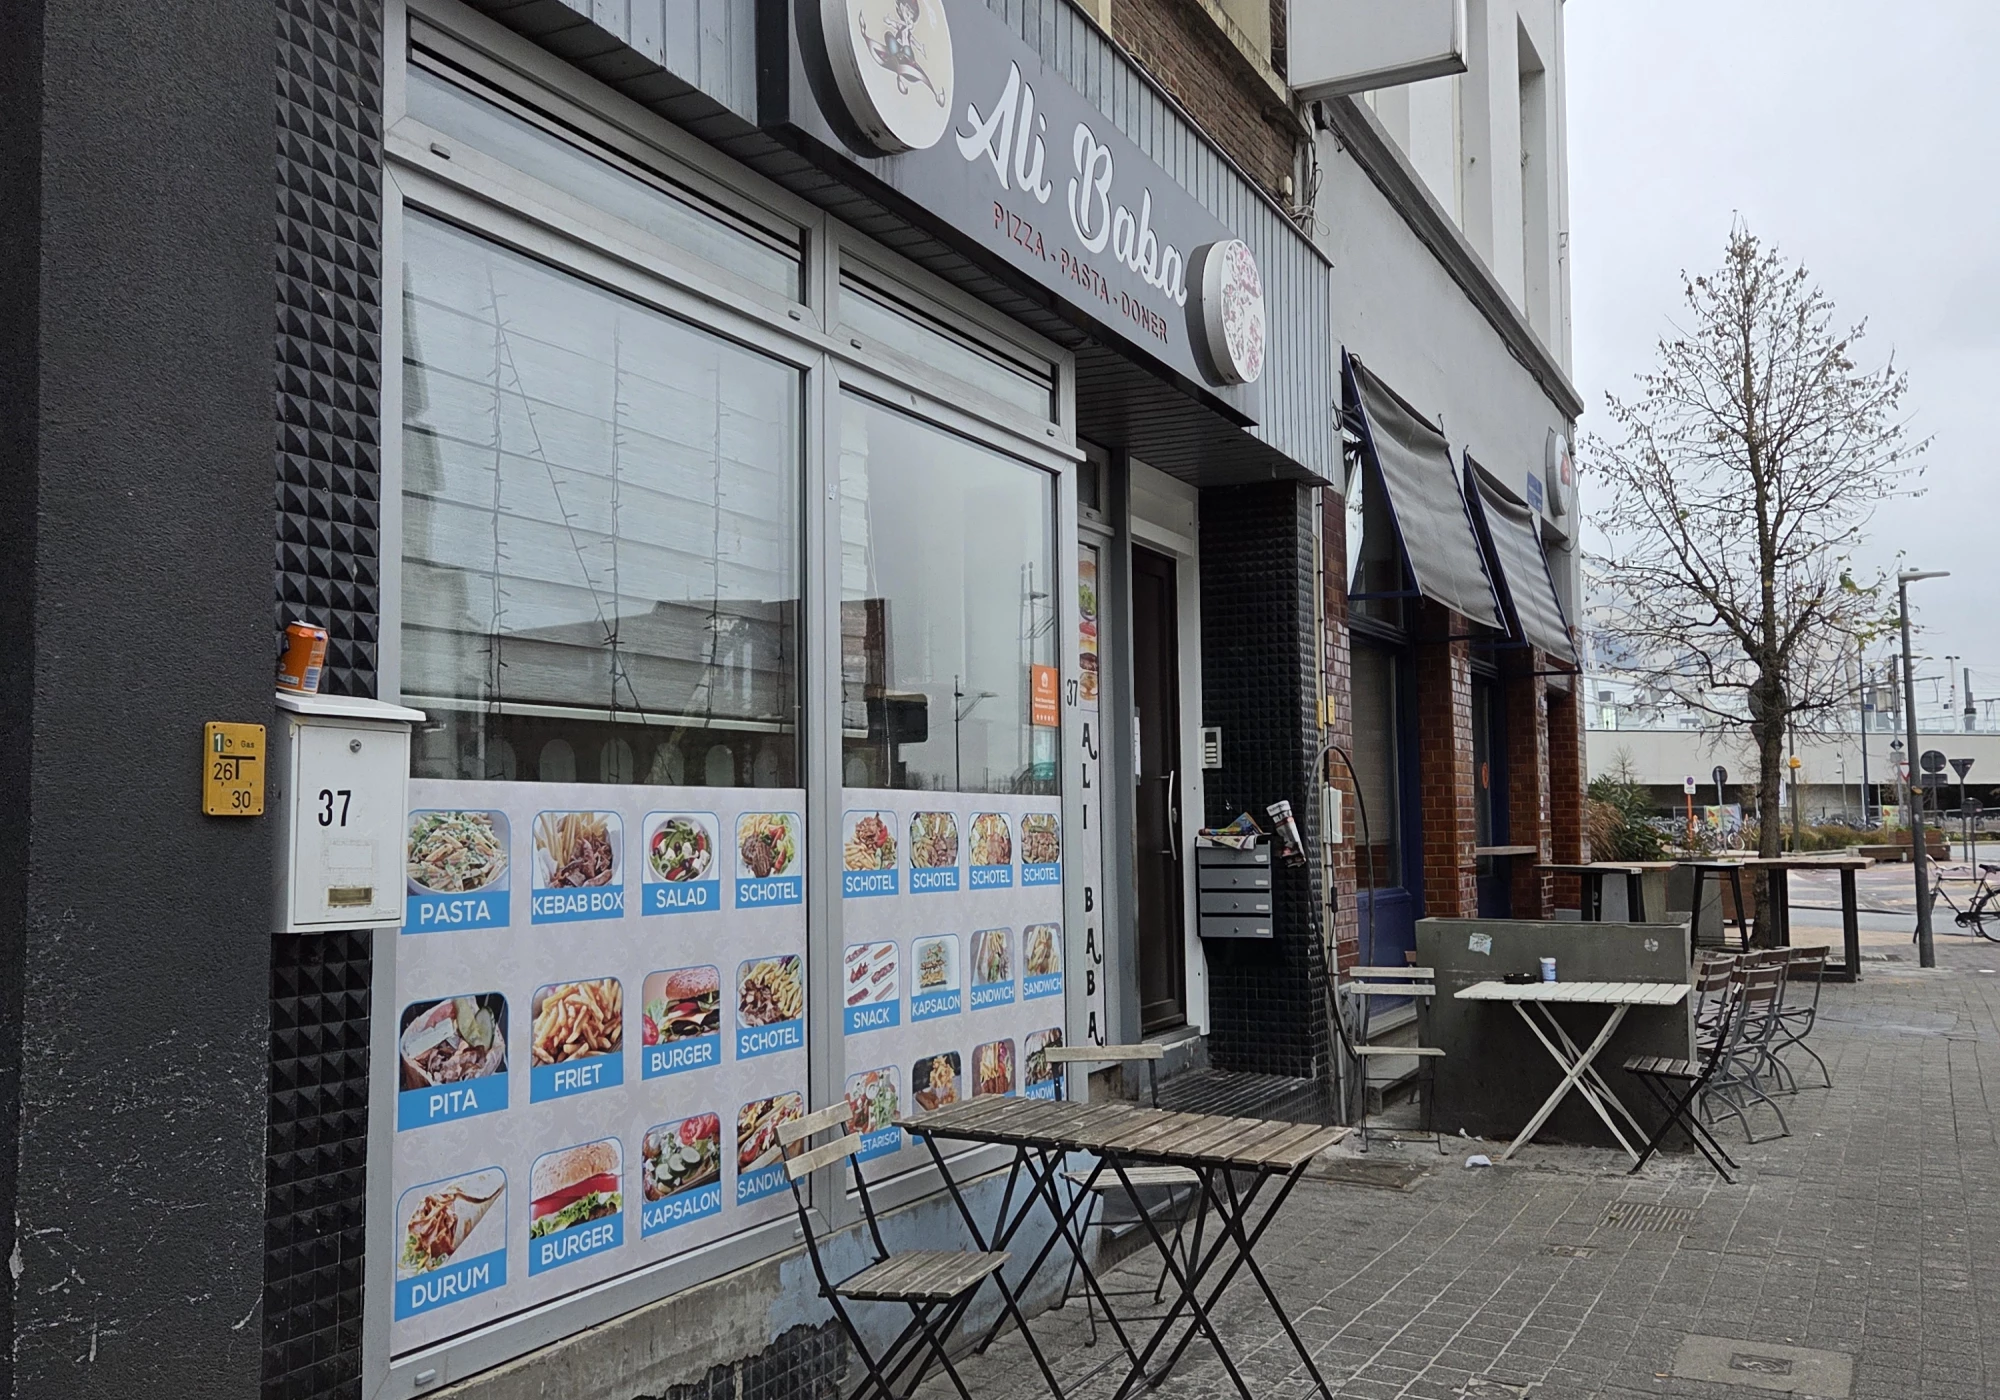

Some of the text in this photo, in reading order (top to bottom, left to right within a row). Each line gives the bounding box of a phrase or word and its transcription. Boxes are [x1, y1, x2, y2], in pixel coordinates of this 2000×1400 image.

[955, 60, 1187, 307] Ali Baba
[992, 201, 1046, 261] PIZZA
[1061, 248, 1109, 305] PASTA
[1121, 291, 1168, 344] DONER
[1066, 679, 1078, 707] 37
[240, 740, 255, 749] Gas
[213, 762, 233, 781] 26
[231, 790, 251, 808] 30
[318, 789, 352, 827] 37
[845, 875, 895, 892] SCHOTEL
[913, 872, 957, 888] SCHOTEL
[971, 869, 1010, 885] SCHOTEL
[1023, 867, 1058, 882] SCHOTEL
[1082, 723, 1104, 1046] ALI BABA
[532, 891, 624, 915] KEBAB BOX
[656, 887, 707, 908] SALAD
[740, 882, 798, 902] SCHOTEL
[420, 900, 491, 925] PASTA
[971, 985, 1015, 1006] SANDWICH
[1023, 978, 1062, 996] SANDWICH
[912, 994, 961, 1016] KAPSALON
[853, 1007, 890, 1028] SNACK
[741, 1028, 800, 1054] SCHOTEL
[651, 1043, 712, 1072] BURGER
[554, 1063, 603, 1092] FRIET
[429, 1088, 478, 1117] PITA
[737, 1169, 788, 1199] SANDW
[642, 1189, 721, 1230] KAPSALON
[541, 1224, 614, 1265] BURGER
[411, 1262, 490, 1308] DURUM
